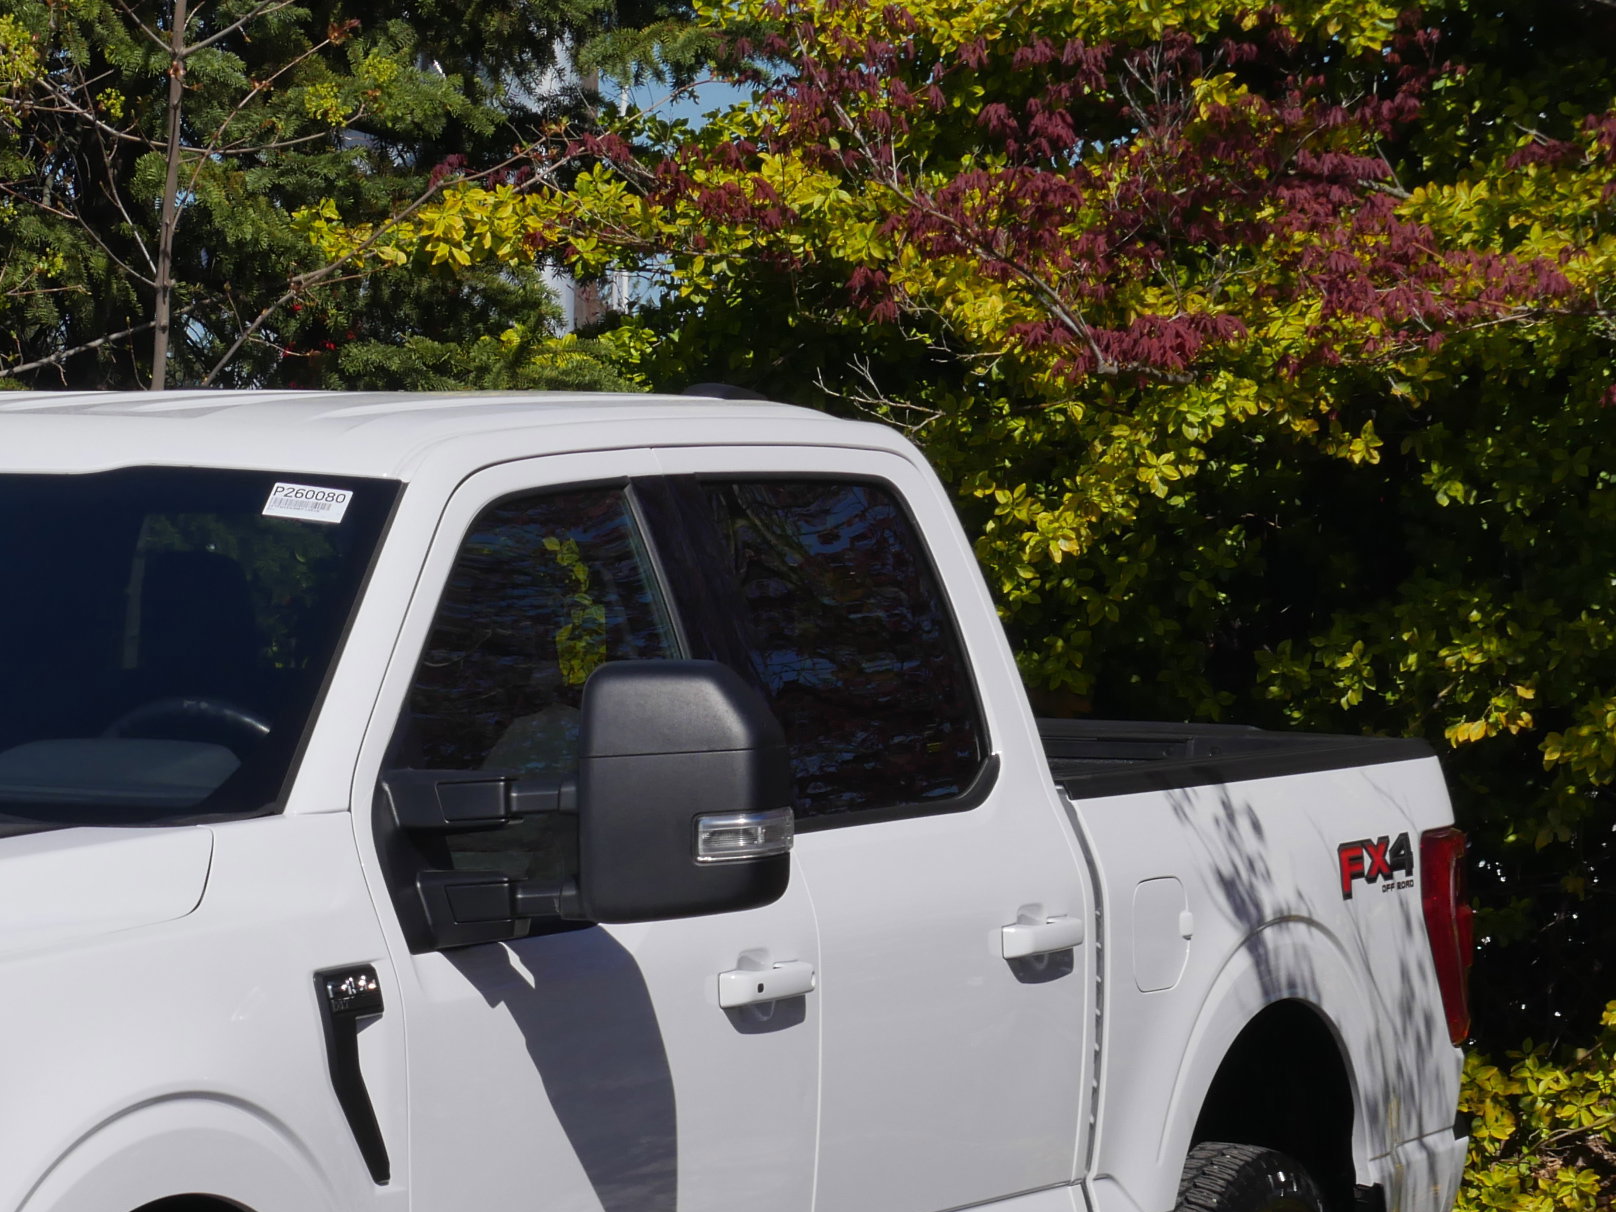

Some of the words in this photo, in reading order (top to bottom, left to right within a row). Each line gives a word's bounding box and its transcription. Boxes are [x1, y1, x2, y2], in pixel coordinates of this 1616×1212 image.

[273, 486, 346, 504] P260080
[1337, 832, 1414, 901] FX4
[1382, 882, 1395, 893] OFF
[1397, 879, 1415, 890] ROAD
